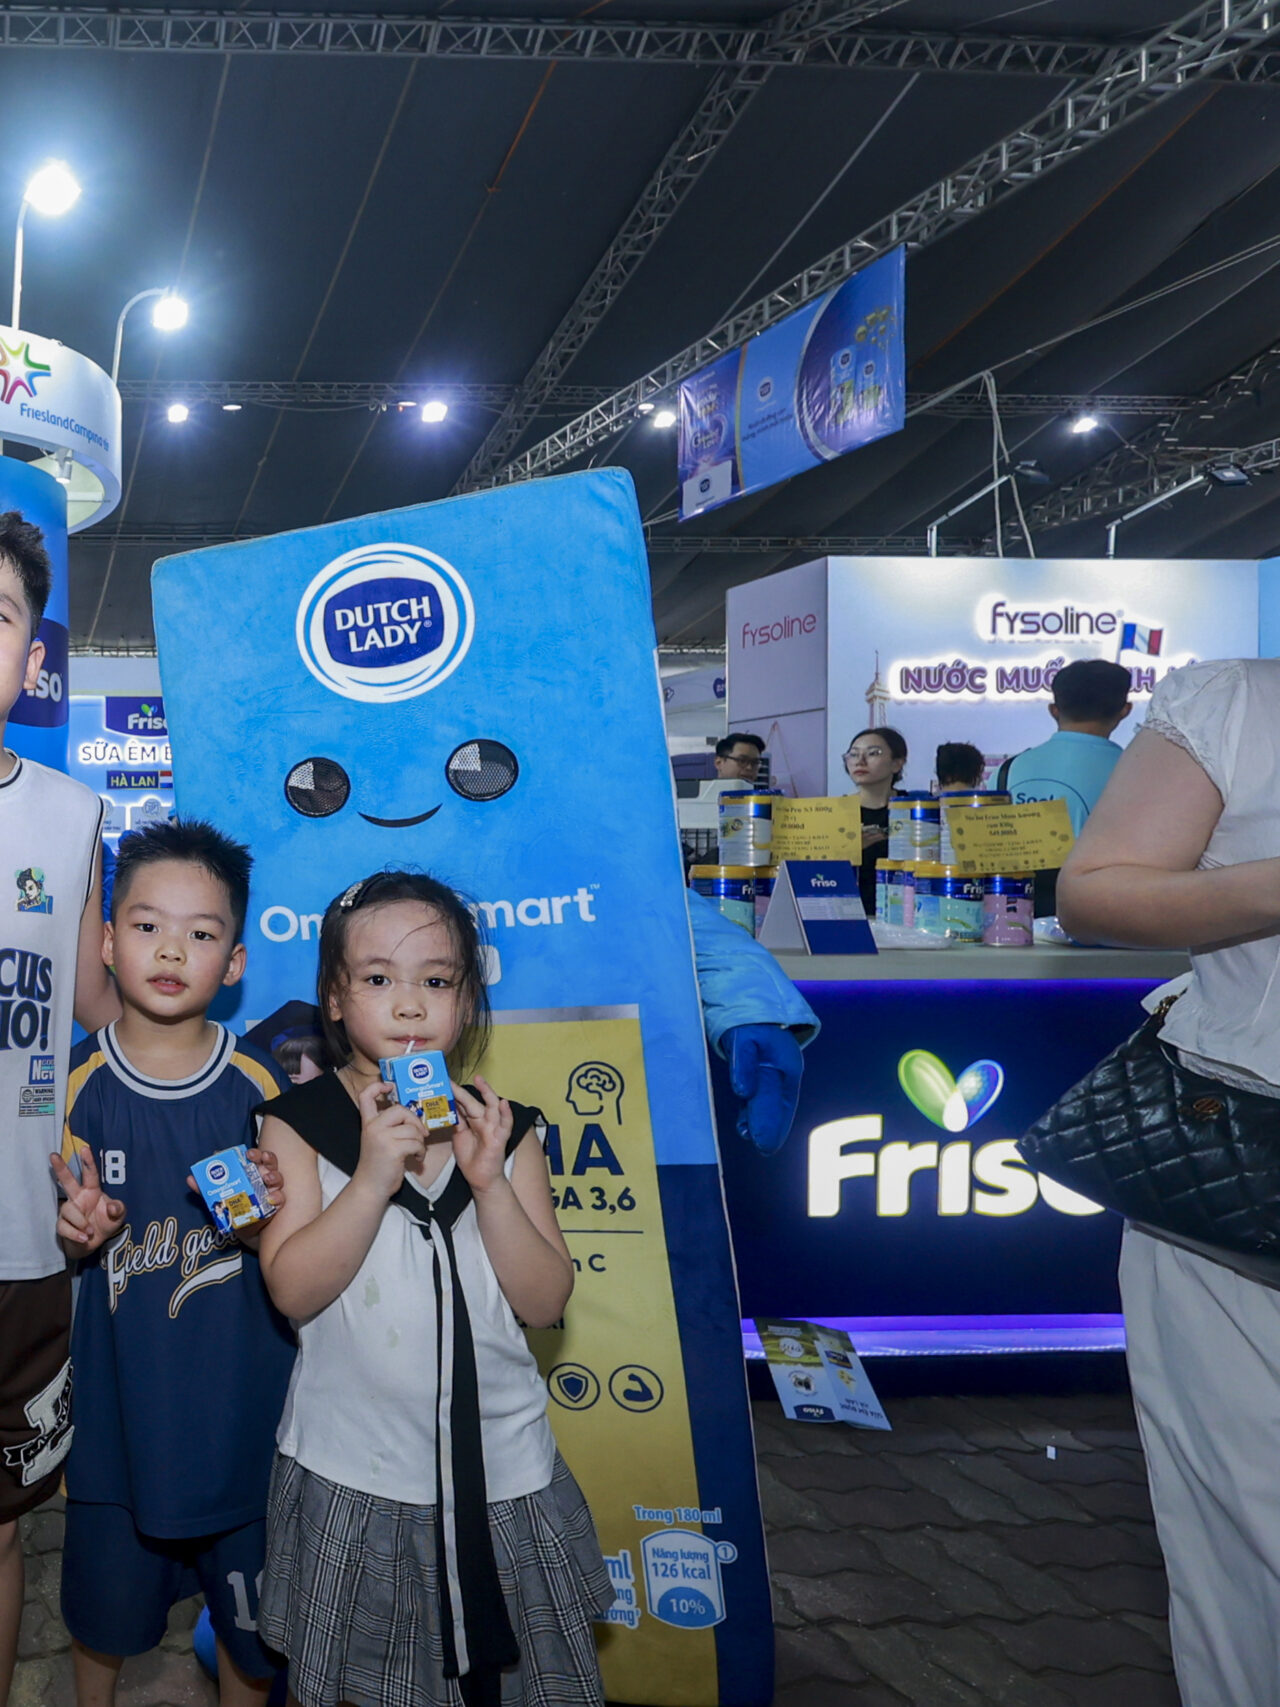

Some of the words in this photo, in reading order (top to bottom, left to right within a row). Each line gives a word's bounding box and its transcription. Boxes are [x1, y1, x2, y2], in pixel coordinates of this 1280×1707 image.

[20, 403, 102, 446] FrieslandCampina
[334, 596, 432, 631] DUTCH
[991, 601, 1117, 635] fysoline
[348, 621, 422, 653] LADY
[742, 613, 817, 649] fysoline
[900, 659, 987, 693] NƯỚC
[127, 712, 167, 730] Fris
[82, 741, 120, 761] SỮA
[111, 772, 128, 787] HÀ
[131, 776, 156, 787] LAN
[810, 878, 837, 888] Friso
[590, 1186, 636, 1214] 3,6
[104, 1217, 178, 1314] Field
[181, 1225, 240, 1279] goo
[588, 1253, 606, 1272] C
[634, 1505, 673, 1524] Trong
[676, 1508, 700, 1522] 180
[702, 1508, 721, 1523] ml
[652, 1563, 678, 1578] 126
[682, 1563, 711, 1579] kcal
[227, 1571, 263, 1632] 1
[670, 1598, 706, 1615] 10%
